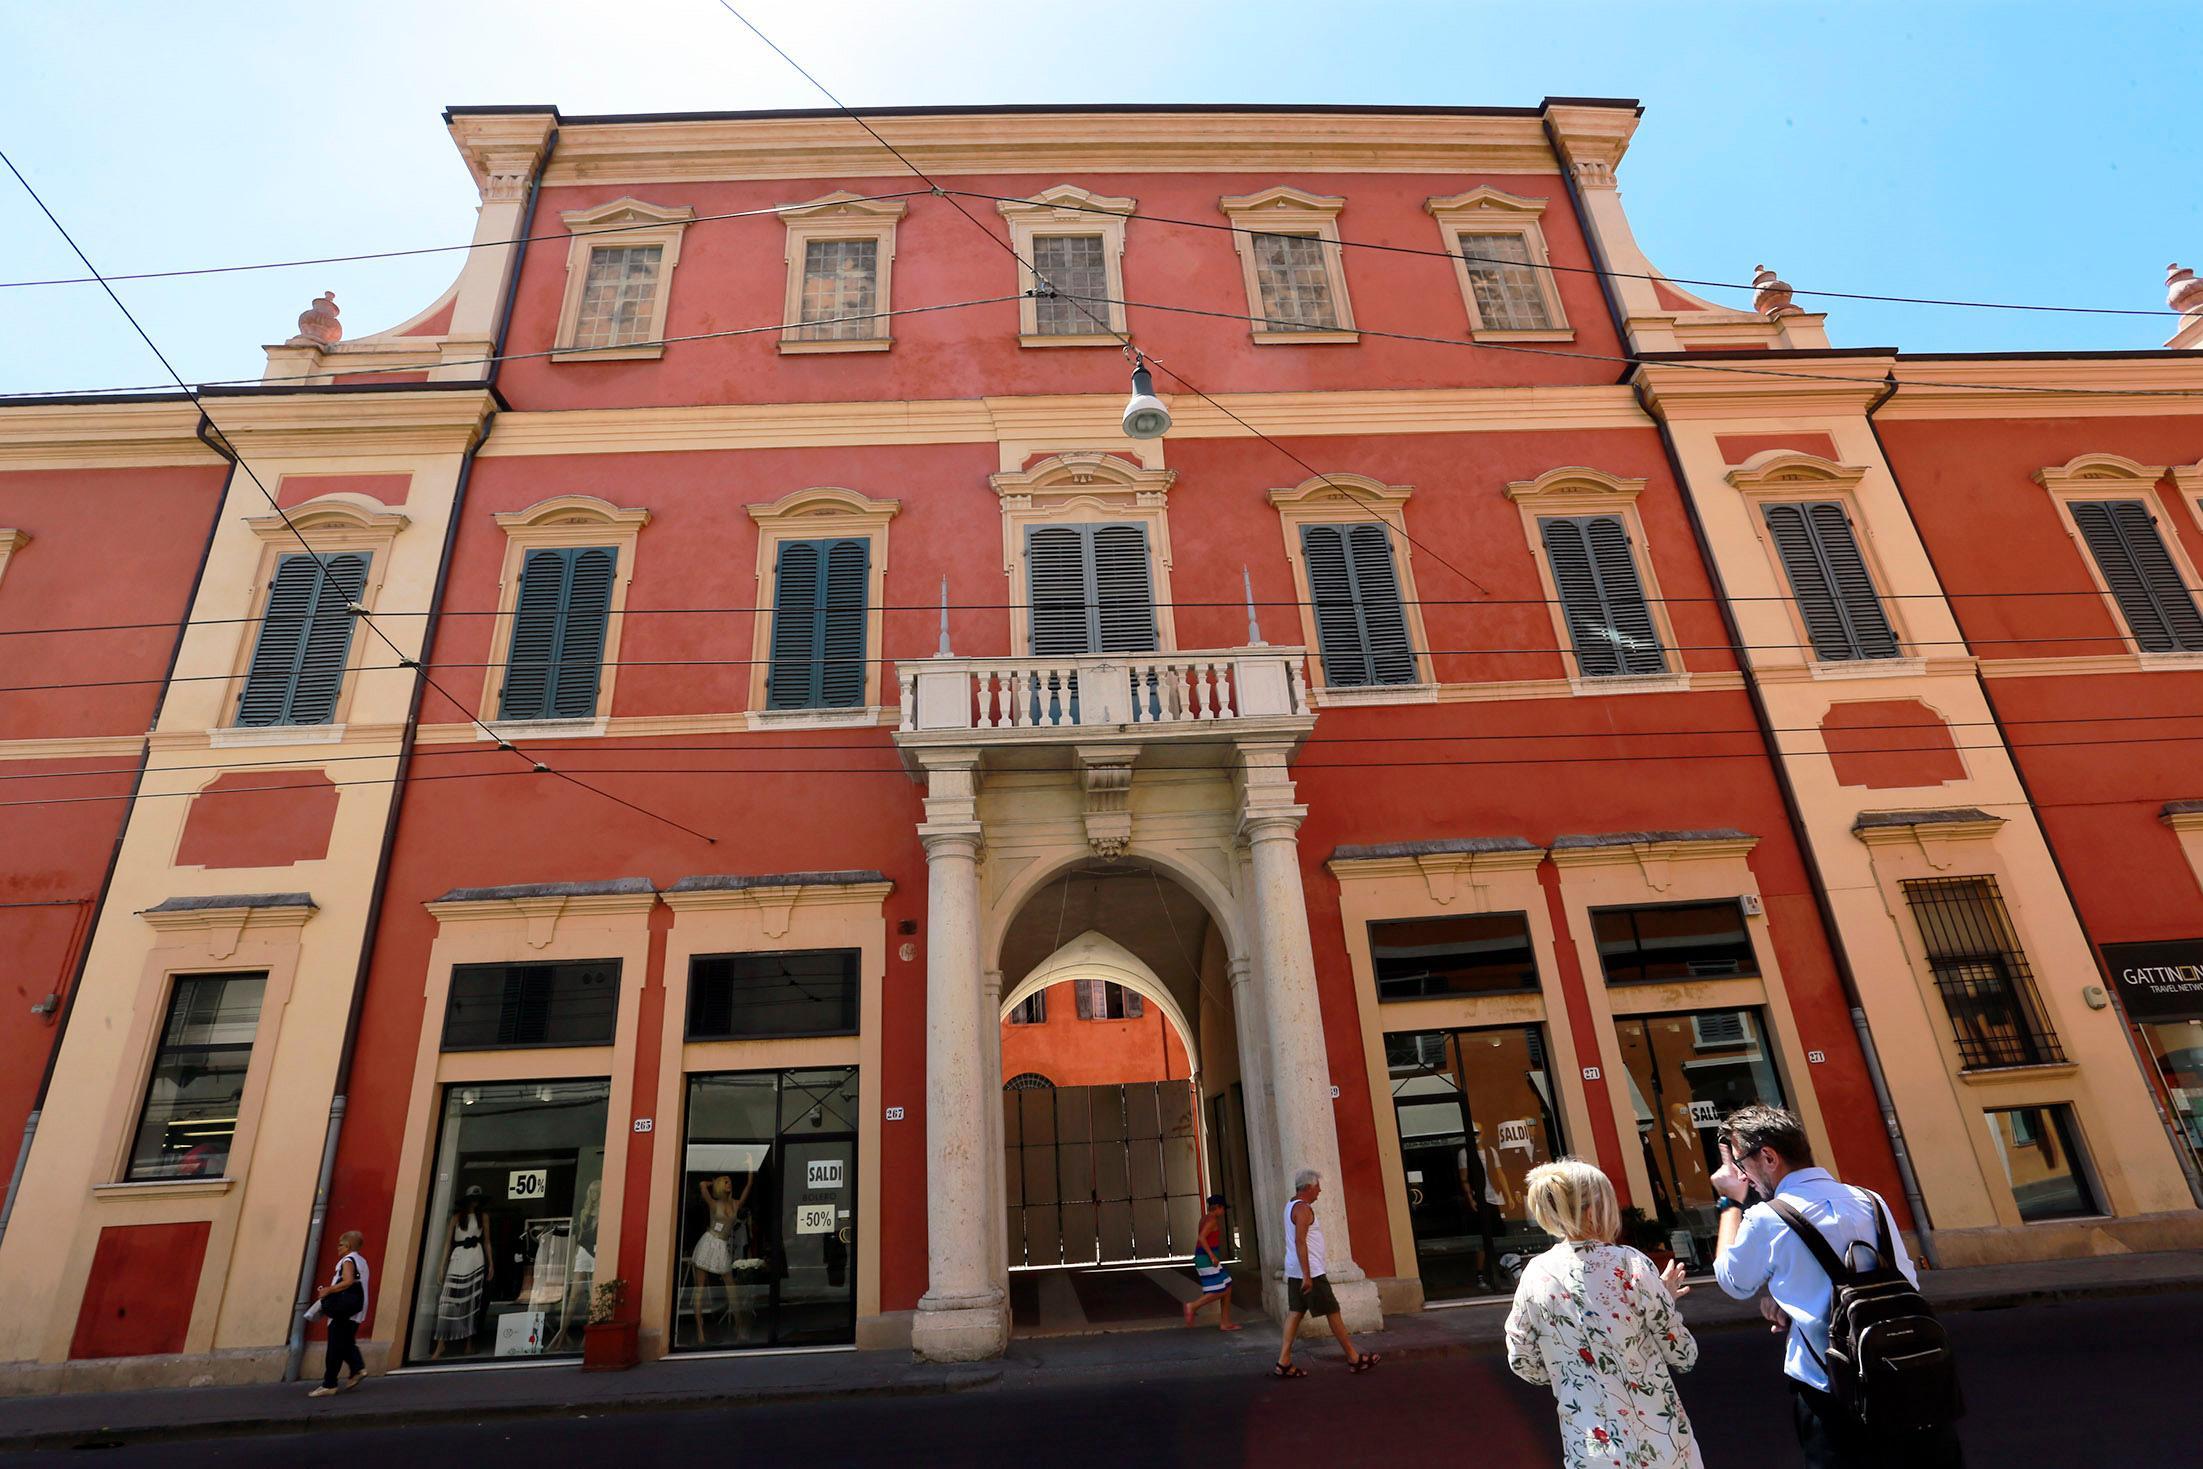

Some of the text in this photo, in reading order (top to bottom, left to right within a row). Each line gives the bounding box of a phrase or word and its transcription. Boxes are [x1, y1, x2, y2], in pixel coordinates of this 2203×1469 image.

[2150, 984, 2179, 993] TRAVEL
[1809, 1052, 1823, 1061] 271
[1585, 1069, 1599, 1078] 271
[887, 1109, 903, 1118] 267
[1500, 1125, 1529, 1143] SALDI
[809, 1166, 842, 1182] SALDI
[509, 1174, 545, 1195] -50%
[800, 1211, 832, 1227] -50%
